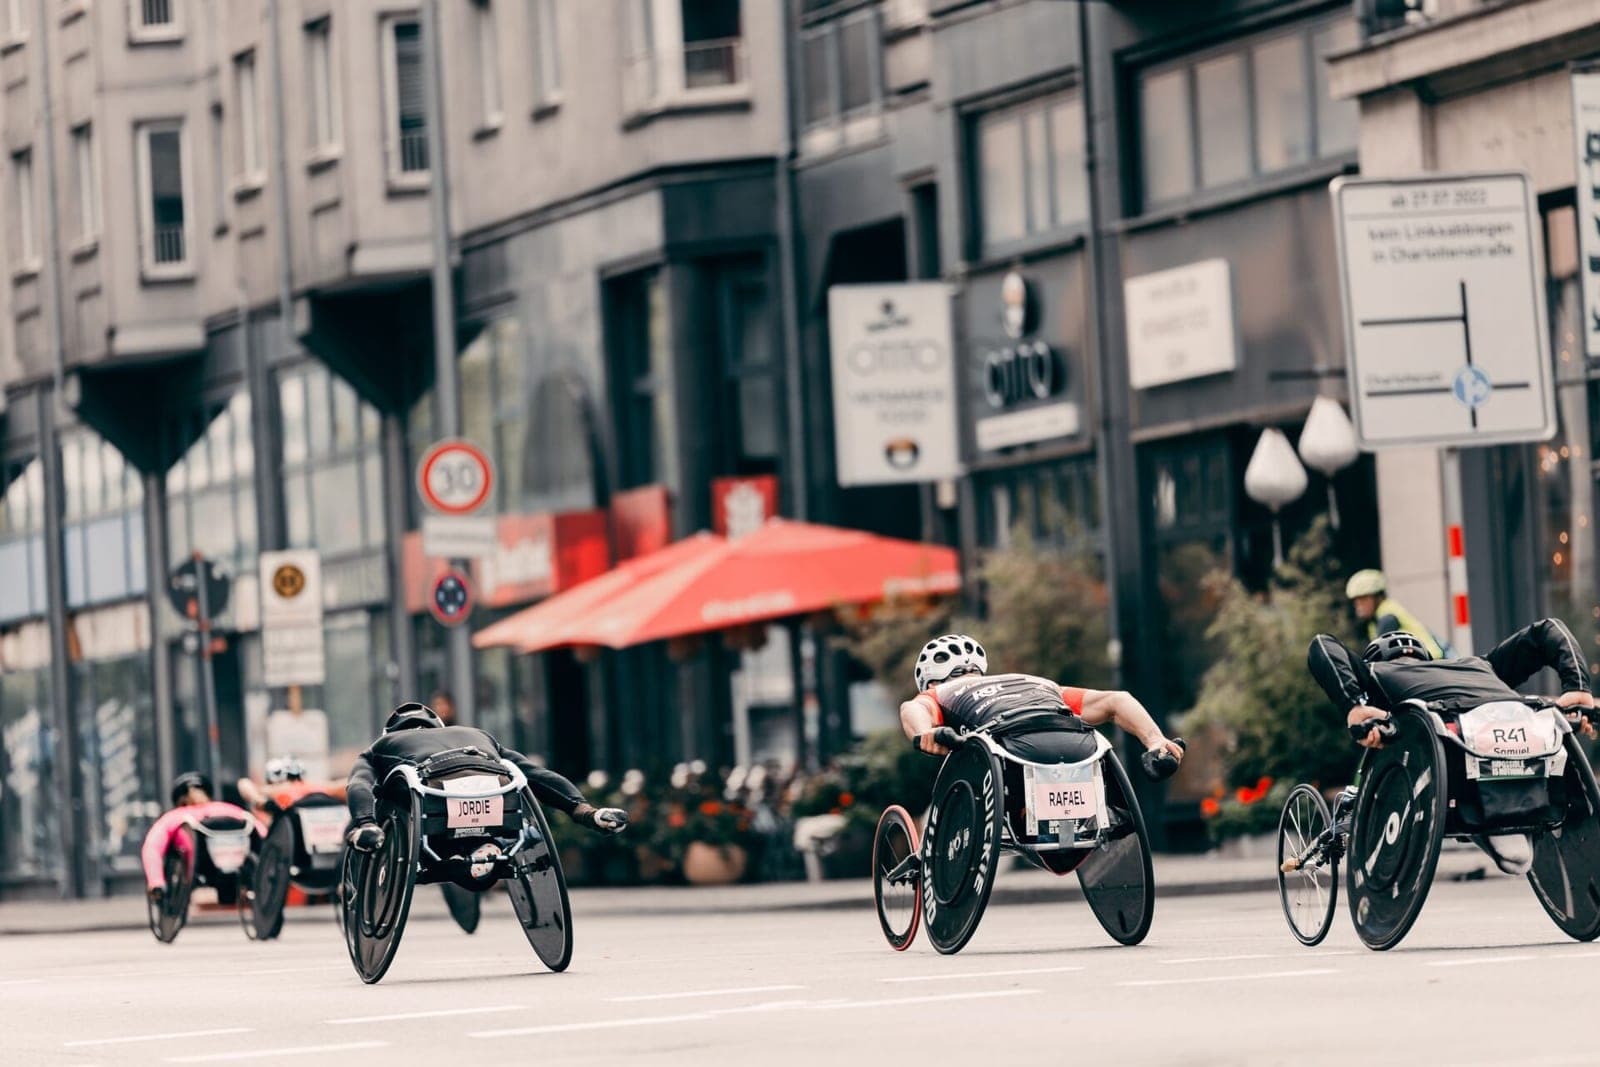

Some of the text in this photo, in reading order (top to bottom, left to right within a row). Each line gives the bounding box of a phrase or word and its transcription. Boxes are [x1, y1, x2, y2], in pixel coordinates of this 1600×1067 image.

[434, 461, 477, 497] 30
[1493, 727, 1526, 743] R41
[1049, 790, 1085, 806] RAFAEL
[458, 800, 490, 817] JORDIE
[973, 769, 995, 895] QUICKIE
